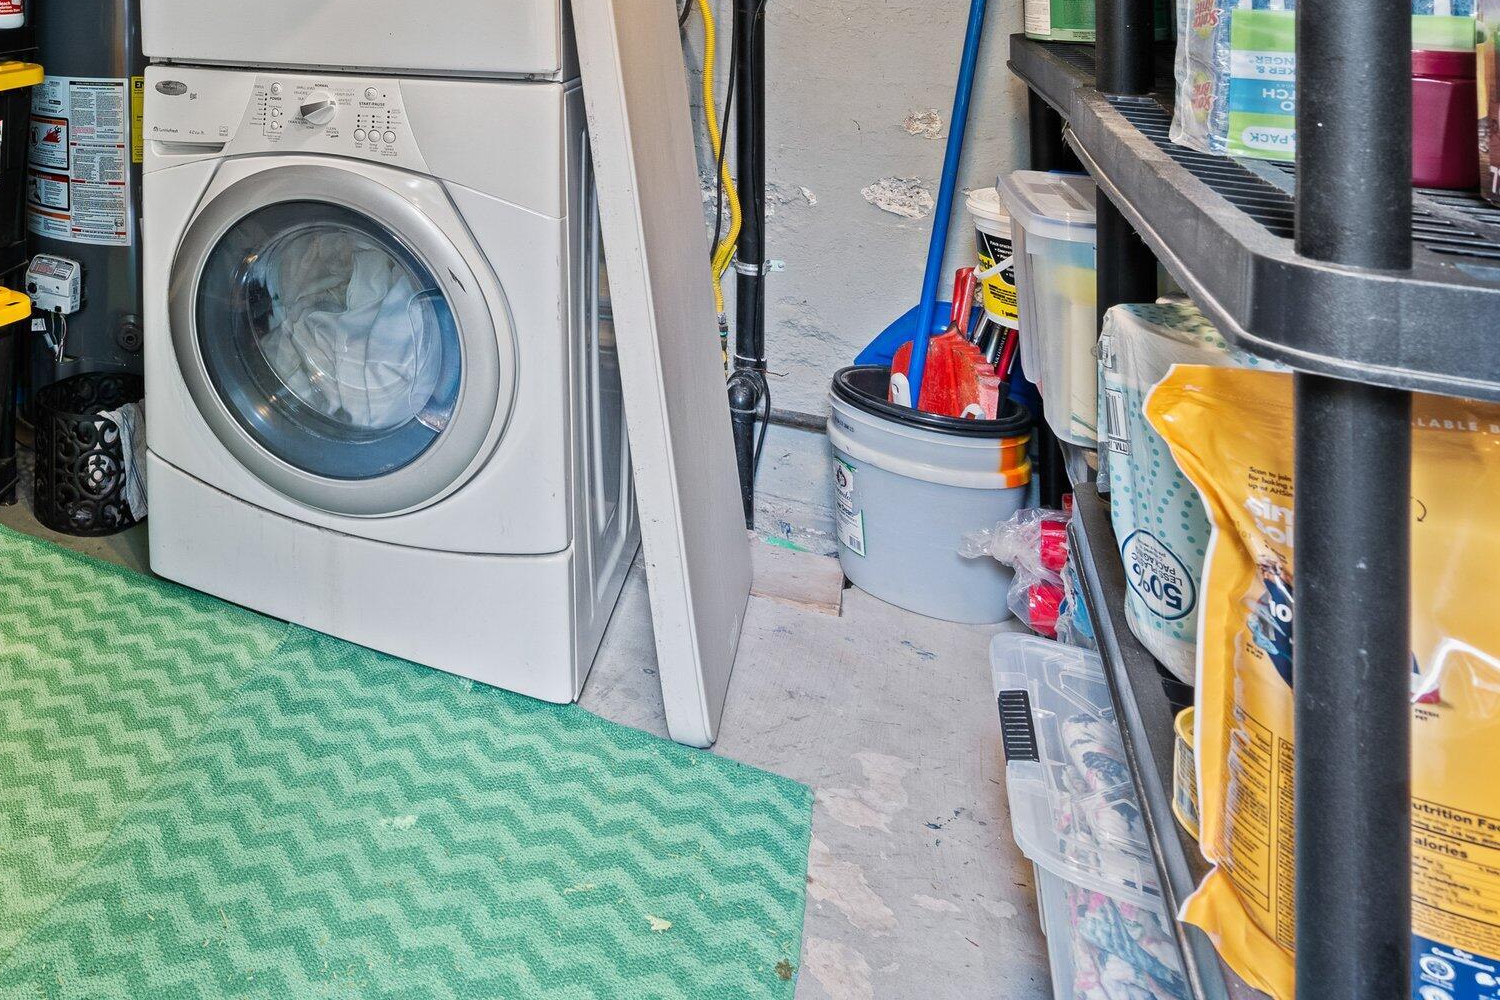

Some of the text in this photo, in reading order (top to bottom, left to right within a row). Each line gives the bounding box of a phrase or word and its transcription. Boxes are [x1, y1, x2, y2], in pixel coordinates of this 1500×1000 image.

[1250, 132, 1288, 145] PACK
[1248, 474, 1288, 490] for baking
[1249, 466, 1267, 475] Scan
[1277, 472, 1292, 482] join
[1248, 483, 1258, 491] up
[1133, 562, 1183, 611] 50%
[1414, 836, 1469, 859] alories
